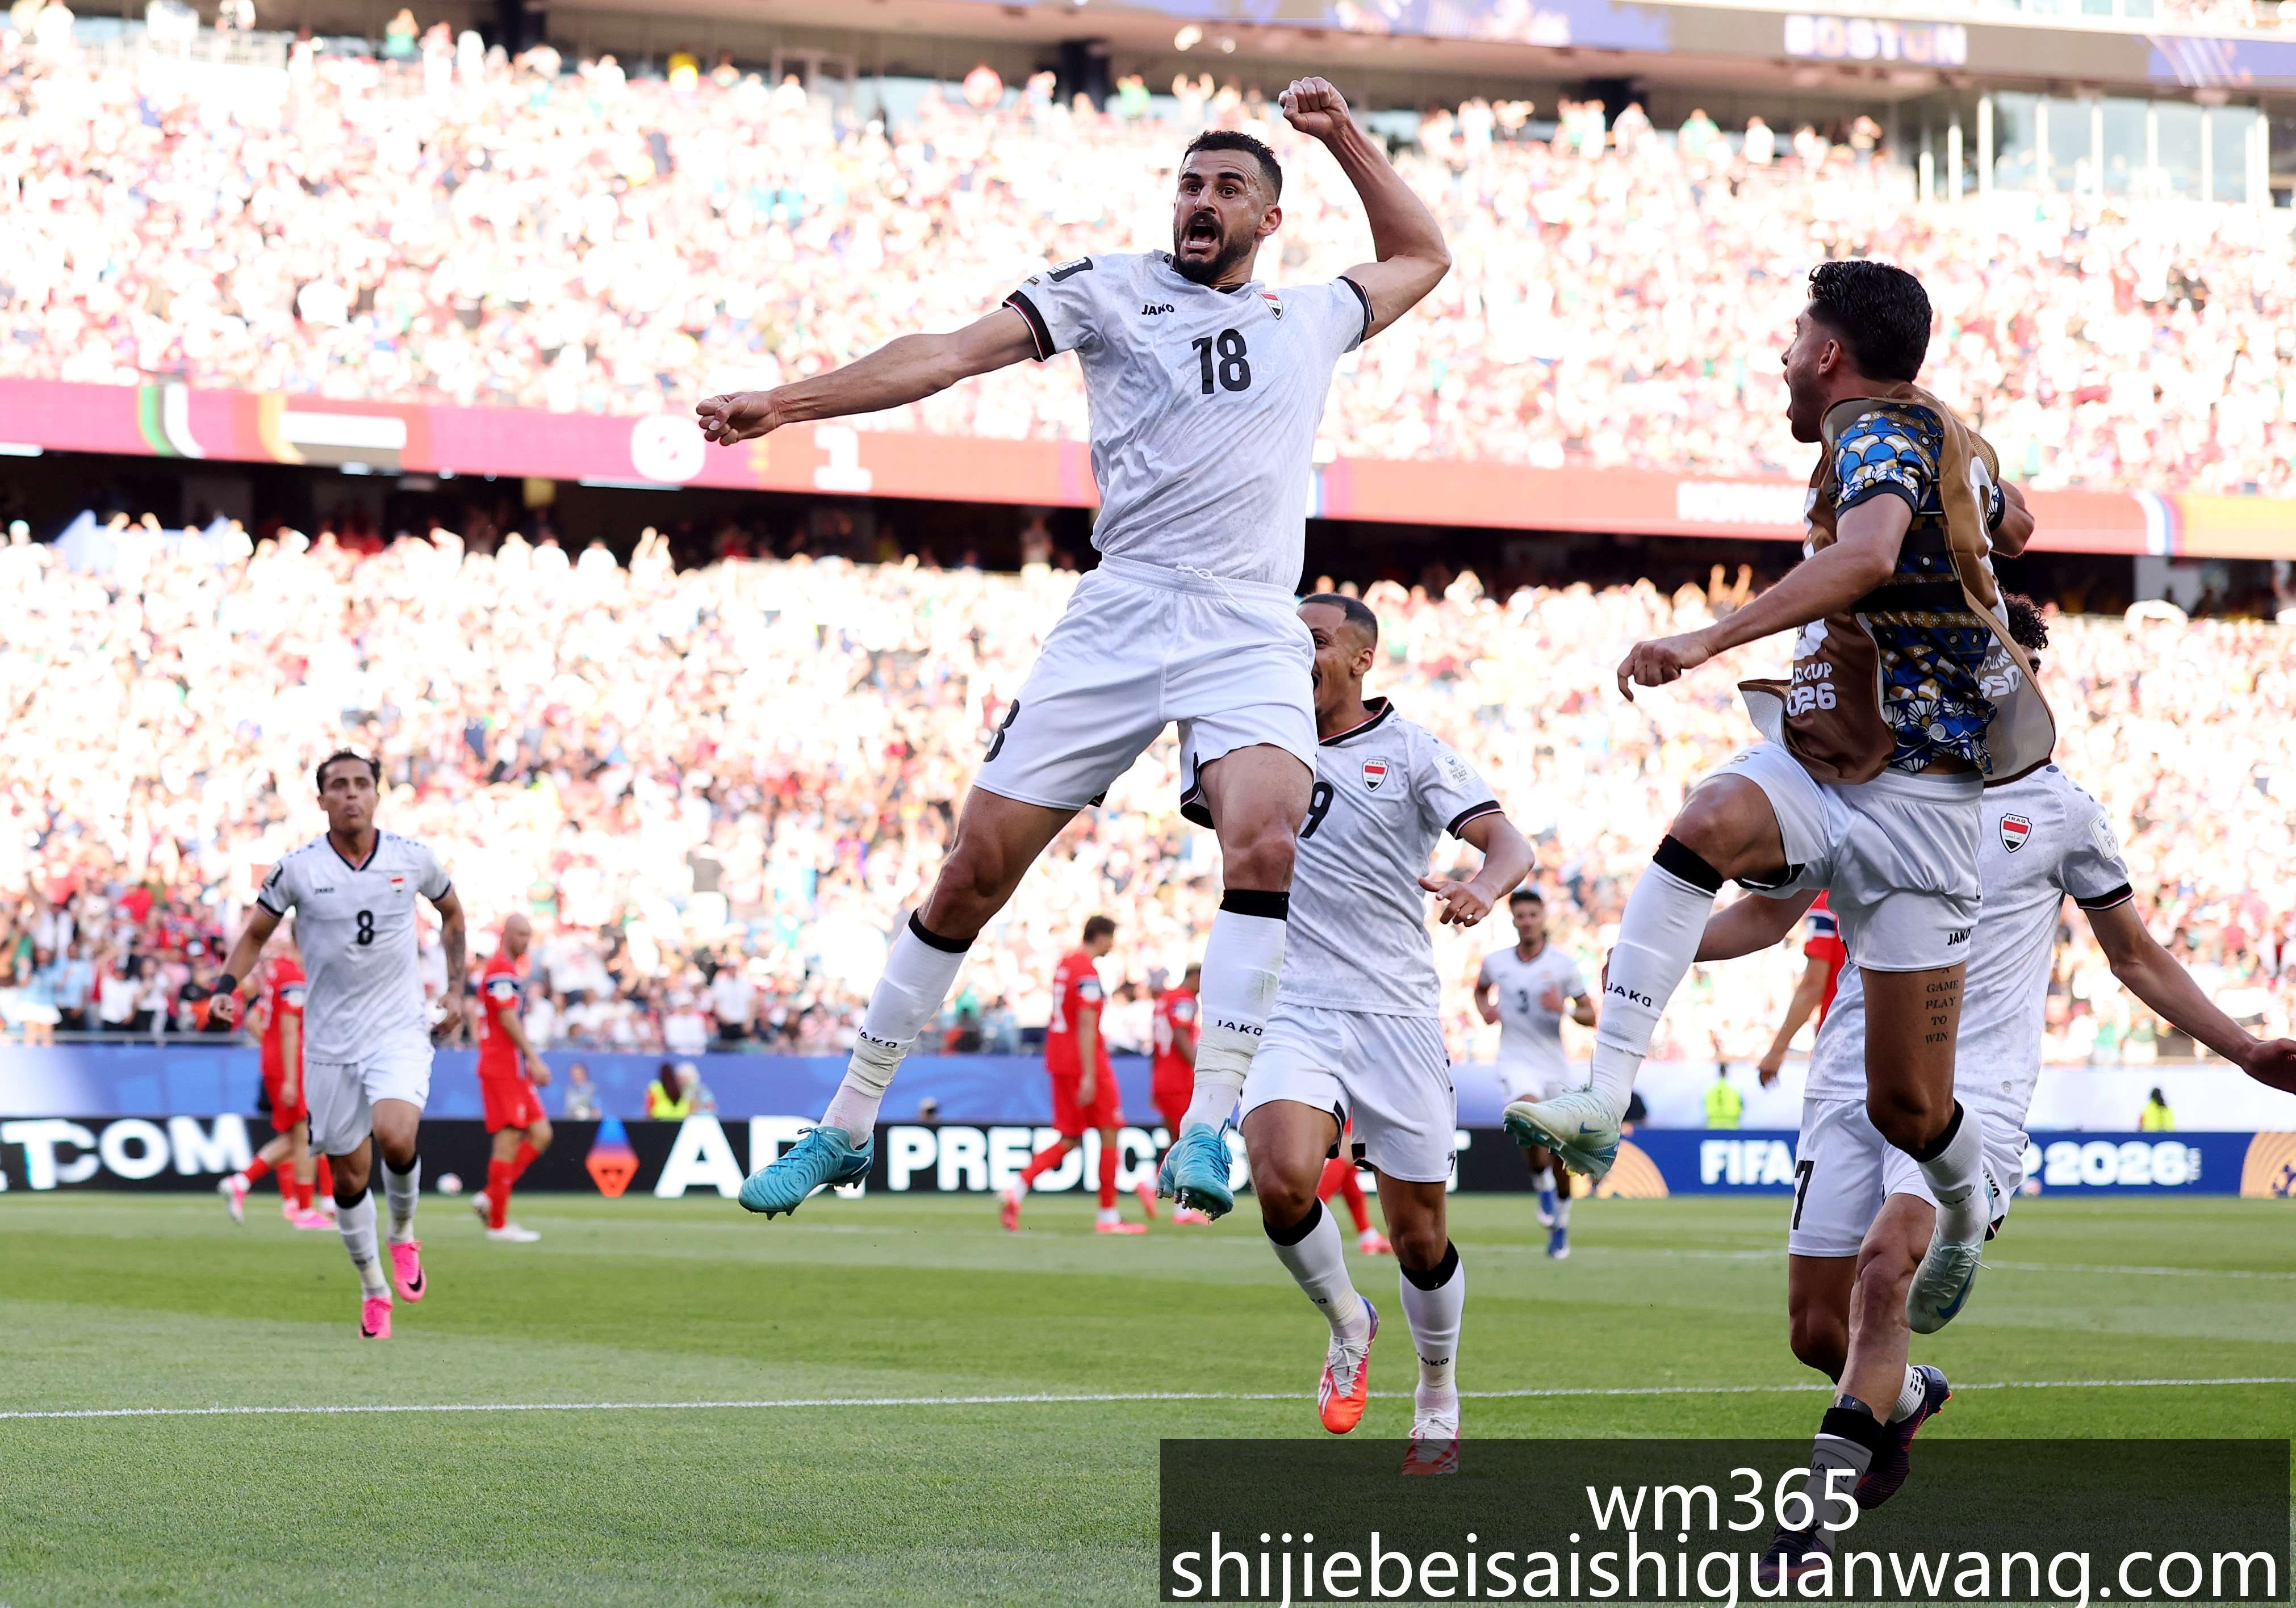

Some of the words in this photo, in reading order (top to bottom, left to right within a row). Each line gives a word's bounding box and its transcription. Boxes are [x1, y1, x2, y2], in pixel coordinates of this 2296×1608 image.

[1784, 15, 1967, 65] BOSTON
[1141, 304, 1174, 315] JAKO
[1192, 328, 1251, 394] 18
[814, 426, 872, 492] 1
[1804, 661, 1833, 682] CUP
[1786, 682, 1837, 718] 026
[1300, 781, 1333, 839] 9
[357, 910, 375, 945] 8
[1947, 928, 1971, 946] JAKO
[1607, 982, 1651, 1007] JAKO
[1926, 979, 1959, 993] GAME
[1926, 996, 1956, 1010] PLAY
[1932, 1015, 1947, 1026] TO
[859, 1026, 897, 1048] AKO
[1926, 1032, 1949, 1044] WIN
[1700, 1138, 1796, 1185] FIFA
[2044, 1140, 2188, 1186] 2026
[1793, 1160, 1814, 1230] 7
